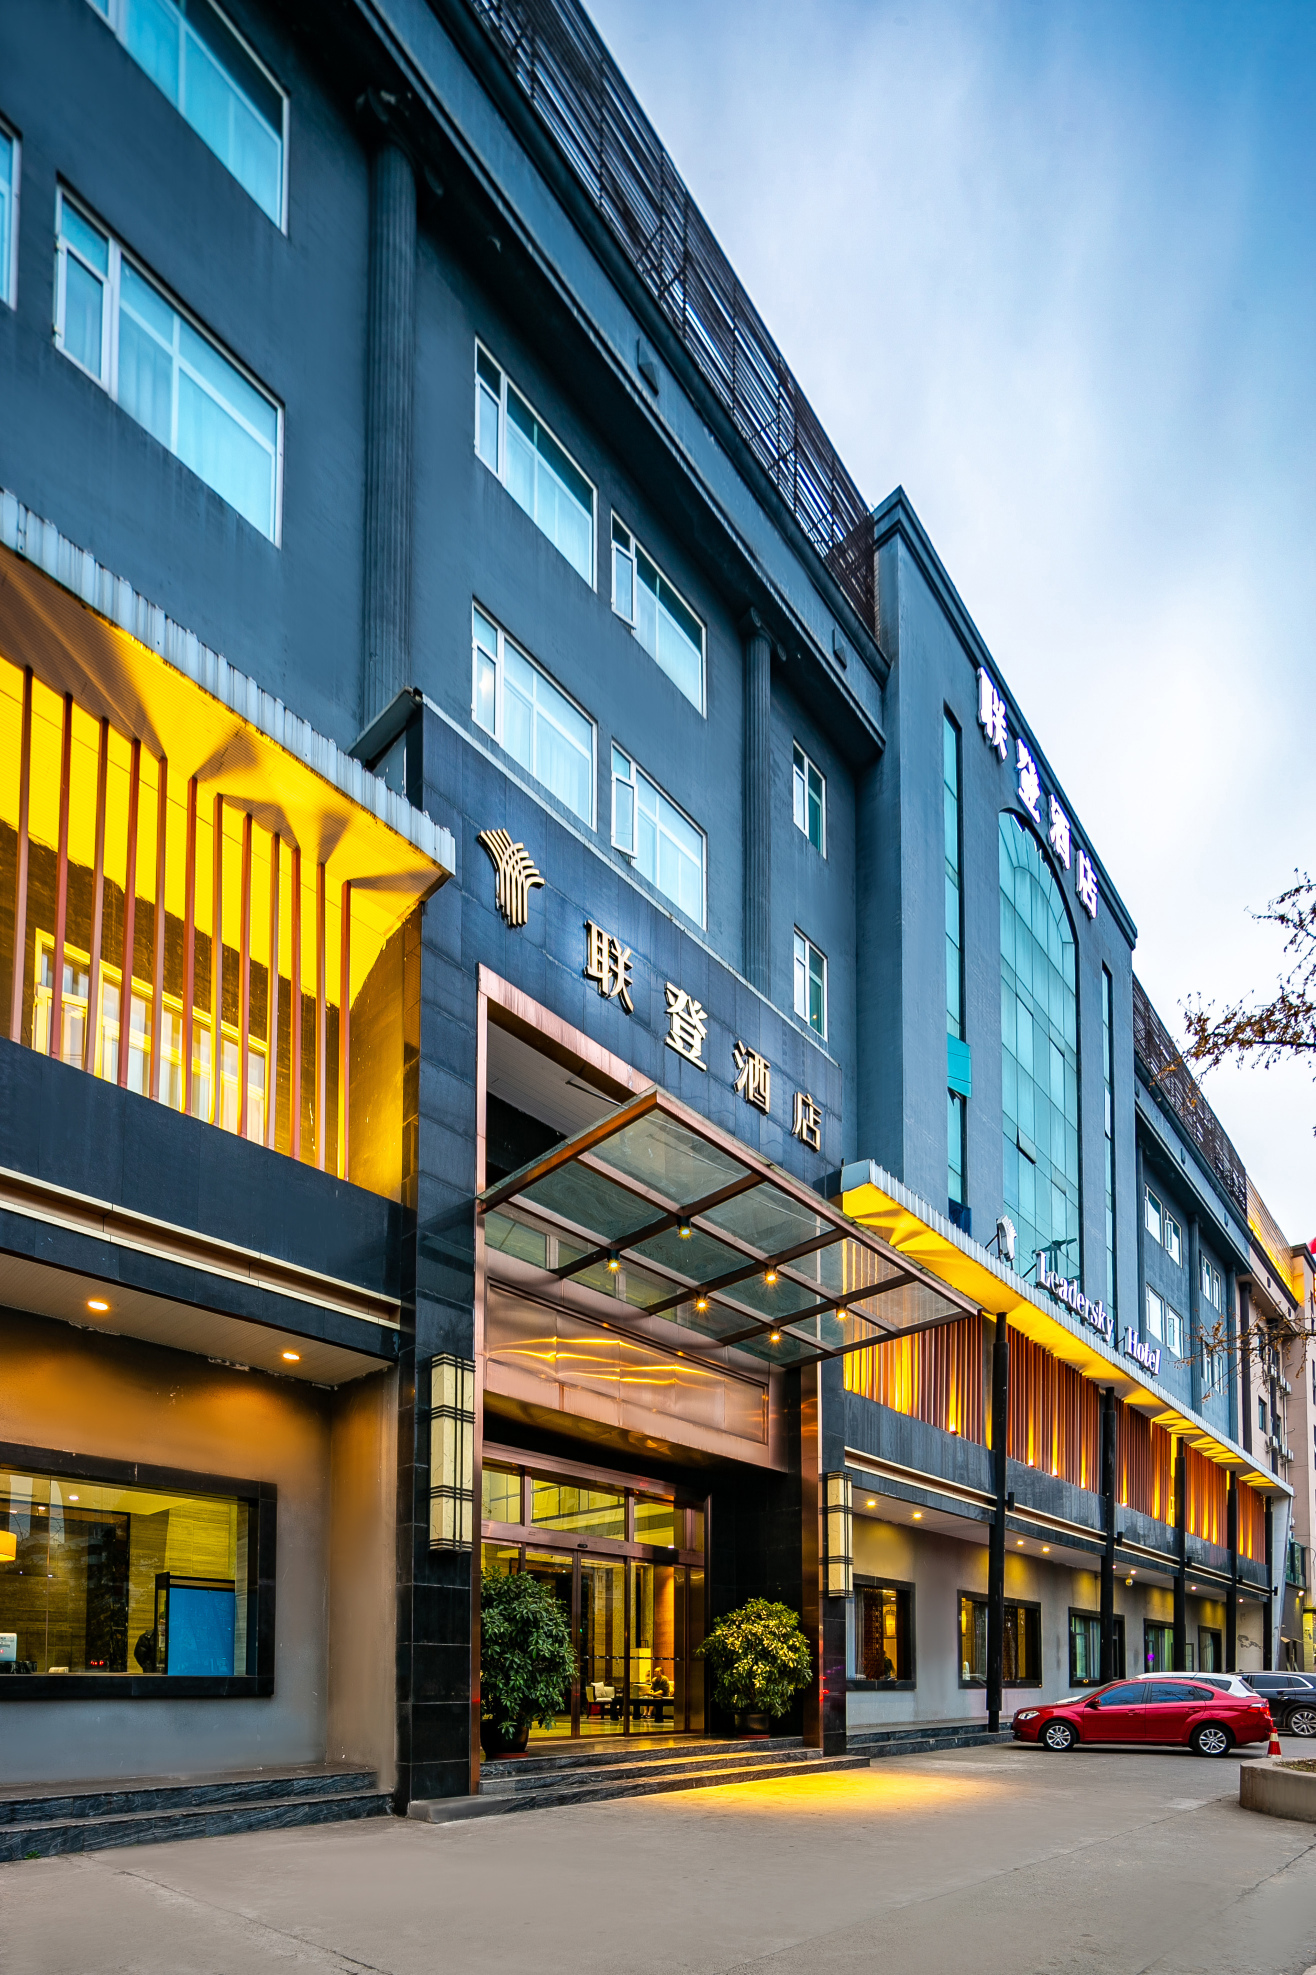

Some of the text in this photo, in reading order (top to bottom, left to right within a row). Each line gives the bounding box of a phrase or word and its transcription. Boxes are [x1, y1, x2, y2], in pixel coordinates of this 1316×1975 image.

[583, 919, 822, 1152] 联登酒店
[1036, 1252, 1161, 1375] Leadersky Hotel
